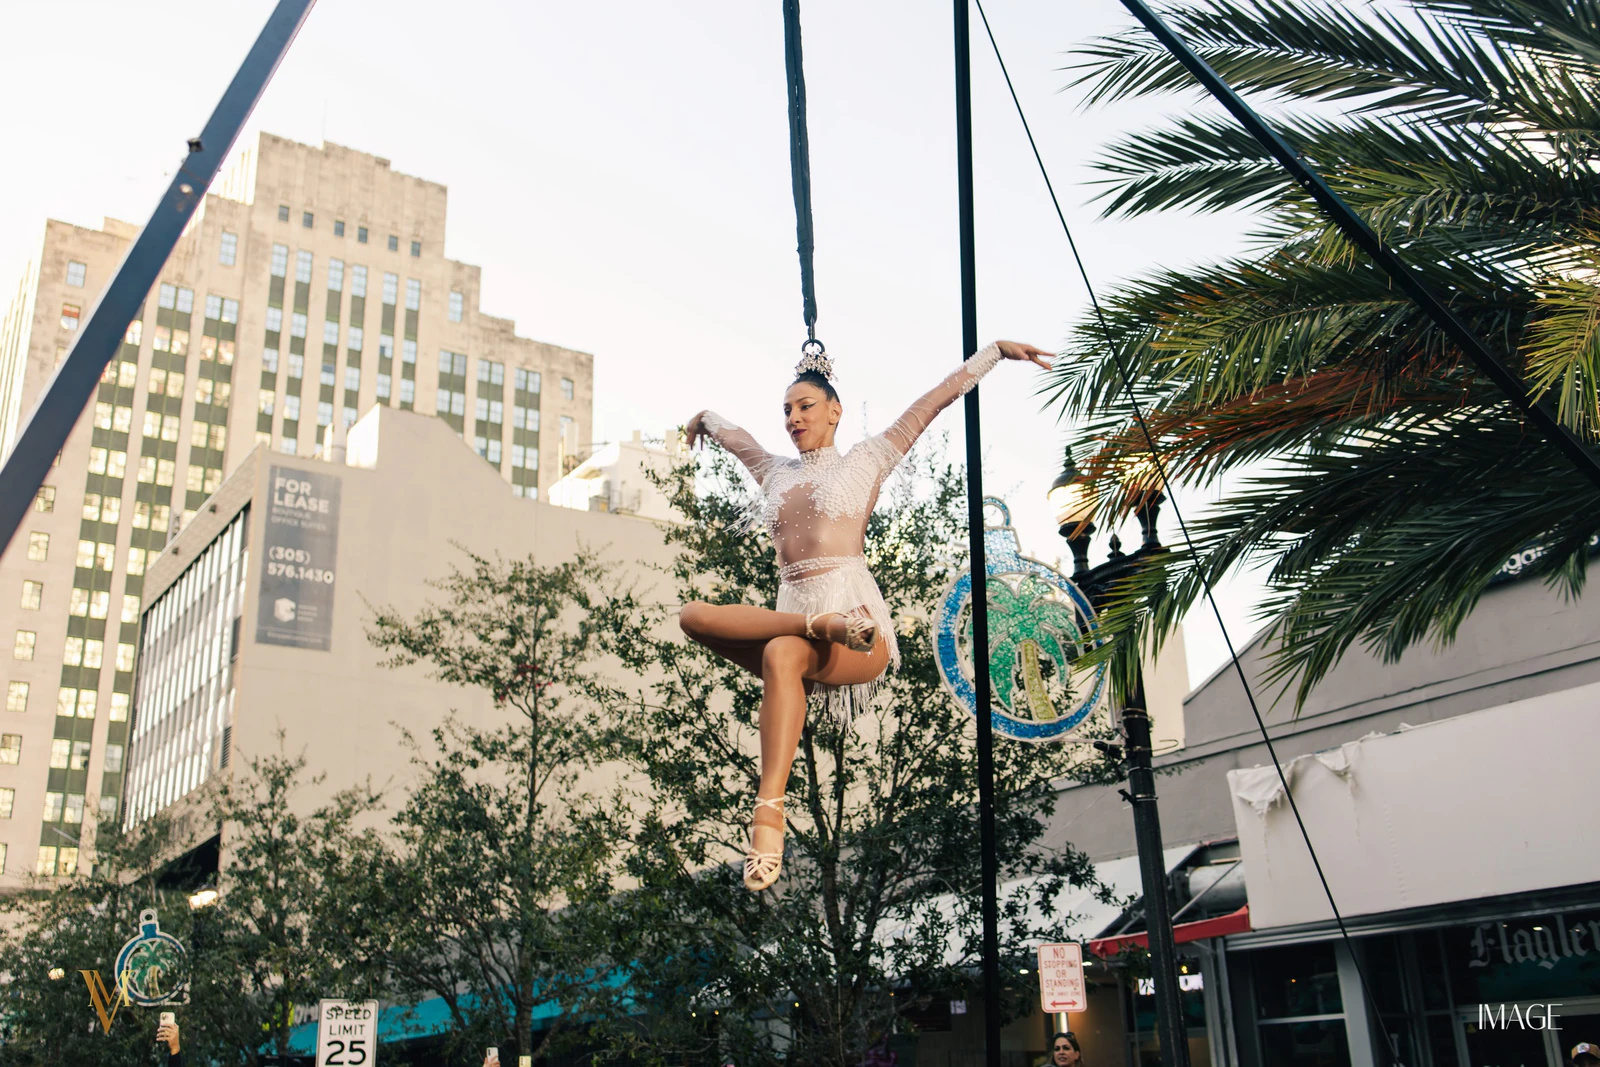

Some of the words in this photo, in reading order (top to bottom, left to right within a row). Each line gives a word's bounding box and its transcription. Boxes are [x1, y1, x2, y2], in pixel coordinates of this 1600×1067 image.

[274, 477, 312, 497] FOR
[273, 491, 329, 514] LEASE
[269, 545, 311, 565] (305)
[267, 562, 334, 584] 576.1430
[1469, 914, 1600, 970] Flagler
[1053, 947, 1065, 959] NO
[1044, 960, 1077, 969] STOPPING
[1056, 970, 1067, 978] OR
[1045, 979, 1079, 988] STANDING
[326, 1007, 371, 1020] SPEED
[329, 1024, 366, 1036] LIMIT
[325, 1040, 367, 1066] 25
